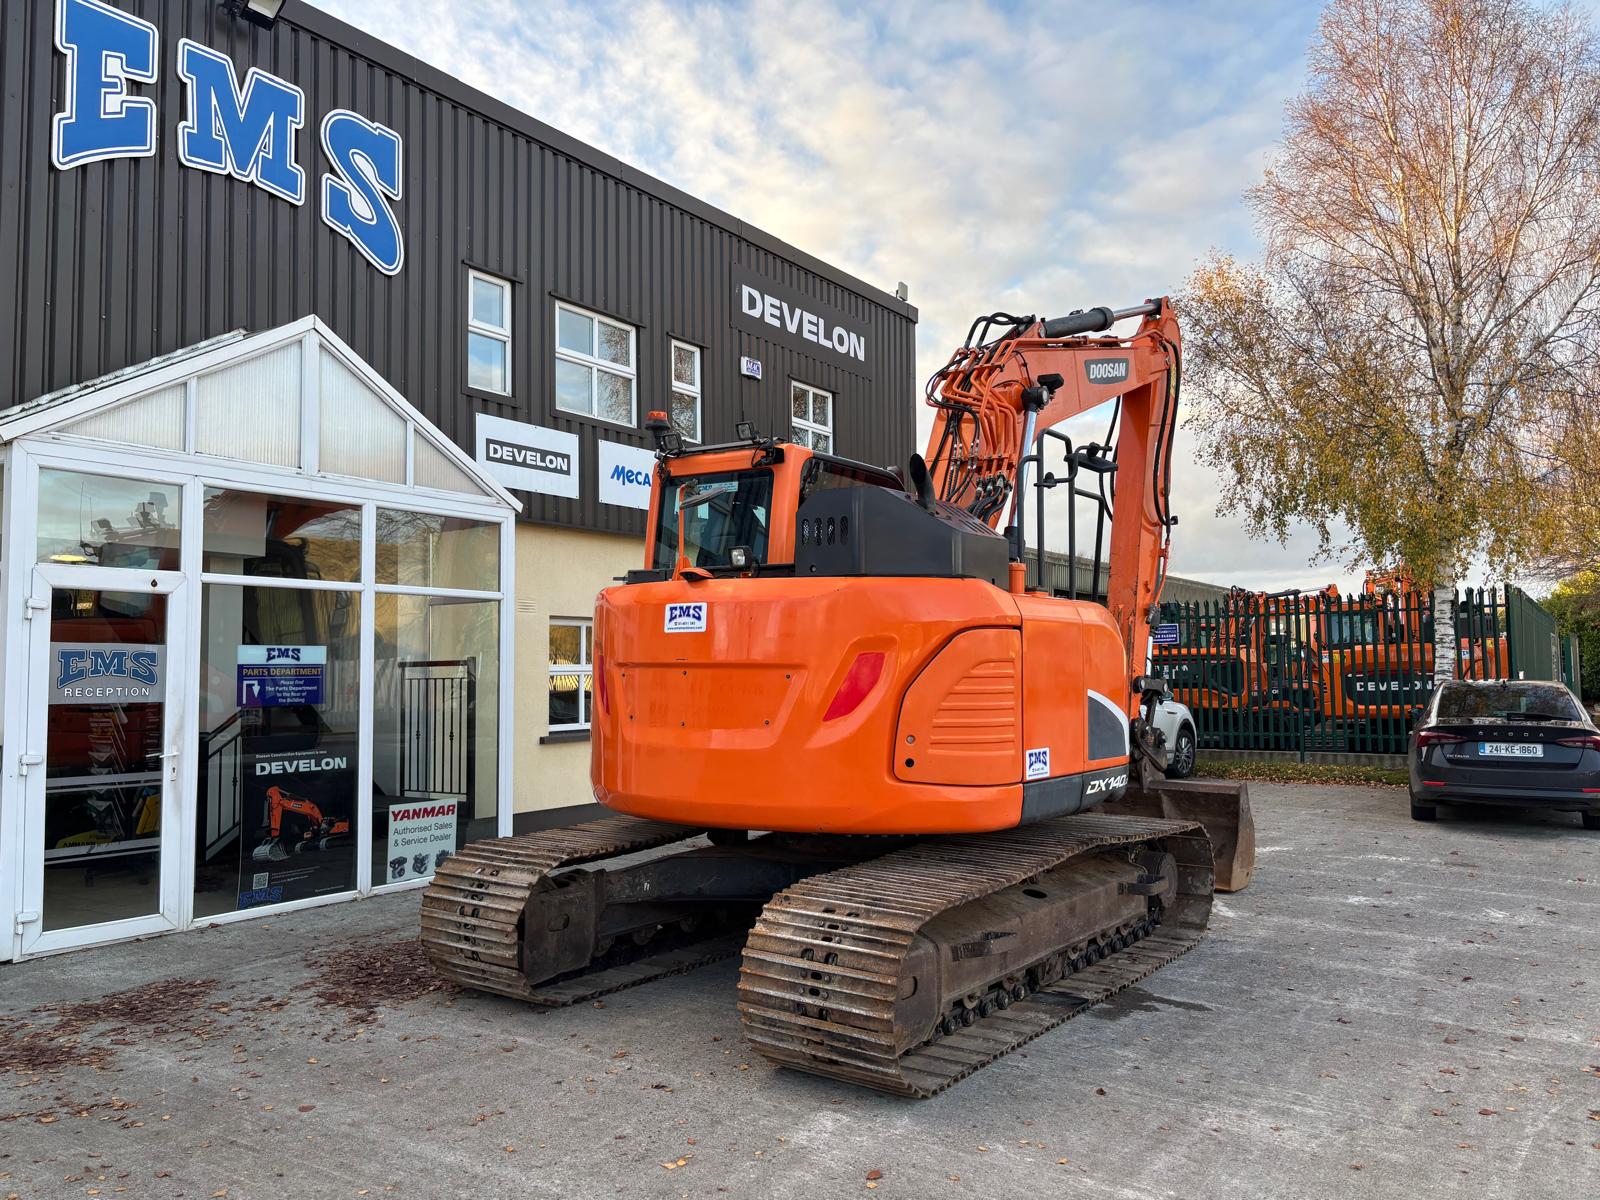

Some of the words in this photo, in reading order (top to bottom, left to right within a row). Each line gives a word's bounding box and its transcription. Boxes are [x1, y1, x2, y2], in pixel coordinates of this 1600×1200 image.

[52, 0, 404, 276] EMS
[741, 284, 865, 362] DEVELON
[1089, 362, 1126, 379] DOOSAN
[489, 443, 568, 471] DEVELON
[669, 605, 702, 622] EMS
[266, 647, 301, 663] EMS
[56, 648, 158, 688] EMS
[242, 668, 268, 676] PARTS
[270, 667, 321, 675] DEPARTMENT
[64, 687, 150, 697] RECEPTION
[1356, 681, 1432, 691] DEVEON
[1489, 744, 1538, 755] 241-KE-1860
[255, 757, 346, 776] DEVELON
[1028, 750, 1047, 769] EMS
[391, 804, 456, 822] YANMAR
[393, 824, 432, 836] Authorised
[434, 821, 453, 831] Sales
[394, 838, 399, 847] &
[401, 835, 428, 846] Service
[429, 832, 452, 843] Dealer
